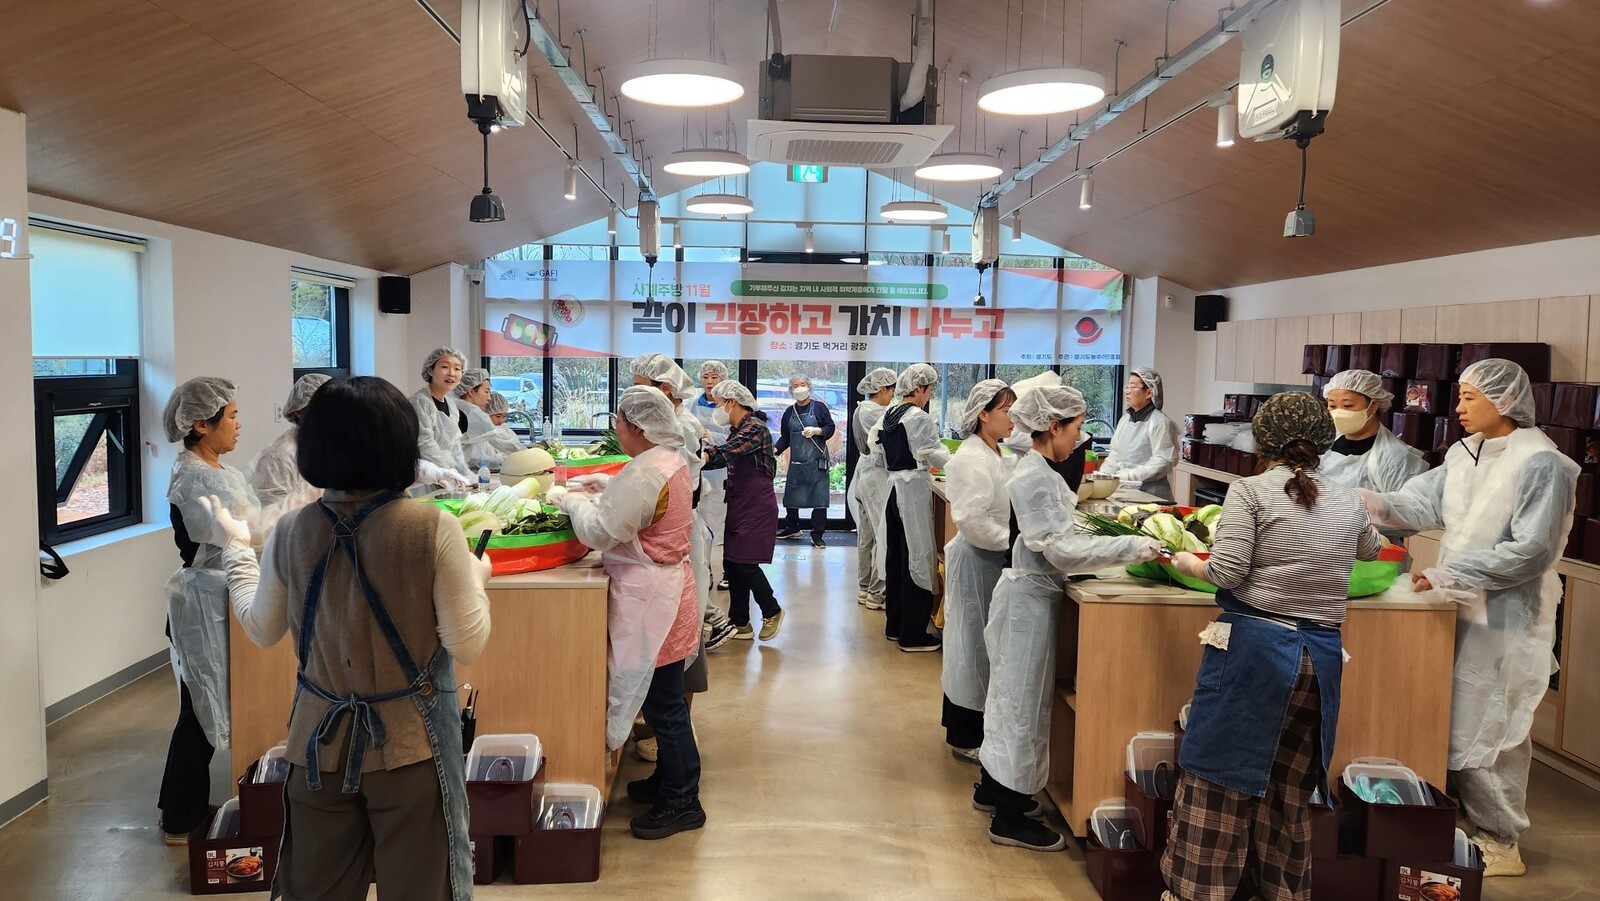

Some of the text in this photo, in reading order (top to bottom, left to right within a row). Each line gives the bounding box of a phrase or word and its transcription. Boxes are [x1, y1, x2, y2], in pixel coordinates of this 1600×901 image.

[539, 269, 558, 277] GAFI
[632, 283, 711, 298] 사계주방 11월
[813, 285, 819, 293] 내
[820, 285, 838, 293] 사회적
[876, 286, 888, 294] 전달
[897, 287, 928, 295] 예정입니다.
[632, 302, 1005, 338] 같이 김장하고 가치 나누고
[770, 341, 787, 350] 장소
[795, 342, 820, 350] 경기도
[822, 342, 848, 350] 먹거리
[850, 342, 867, 351] 광장
[1400, 877, 1418, 886] 김치통
